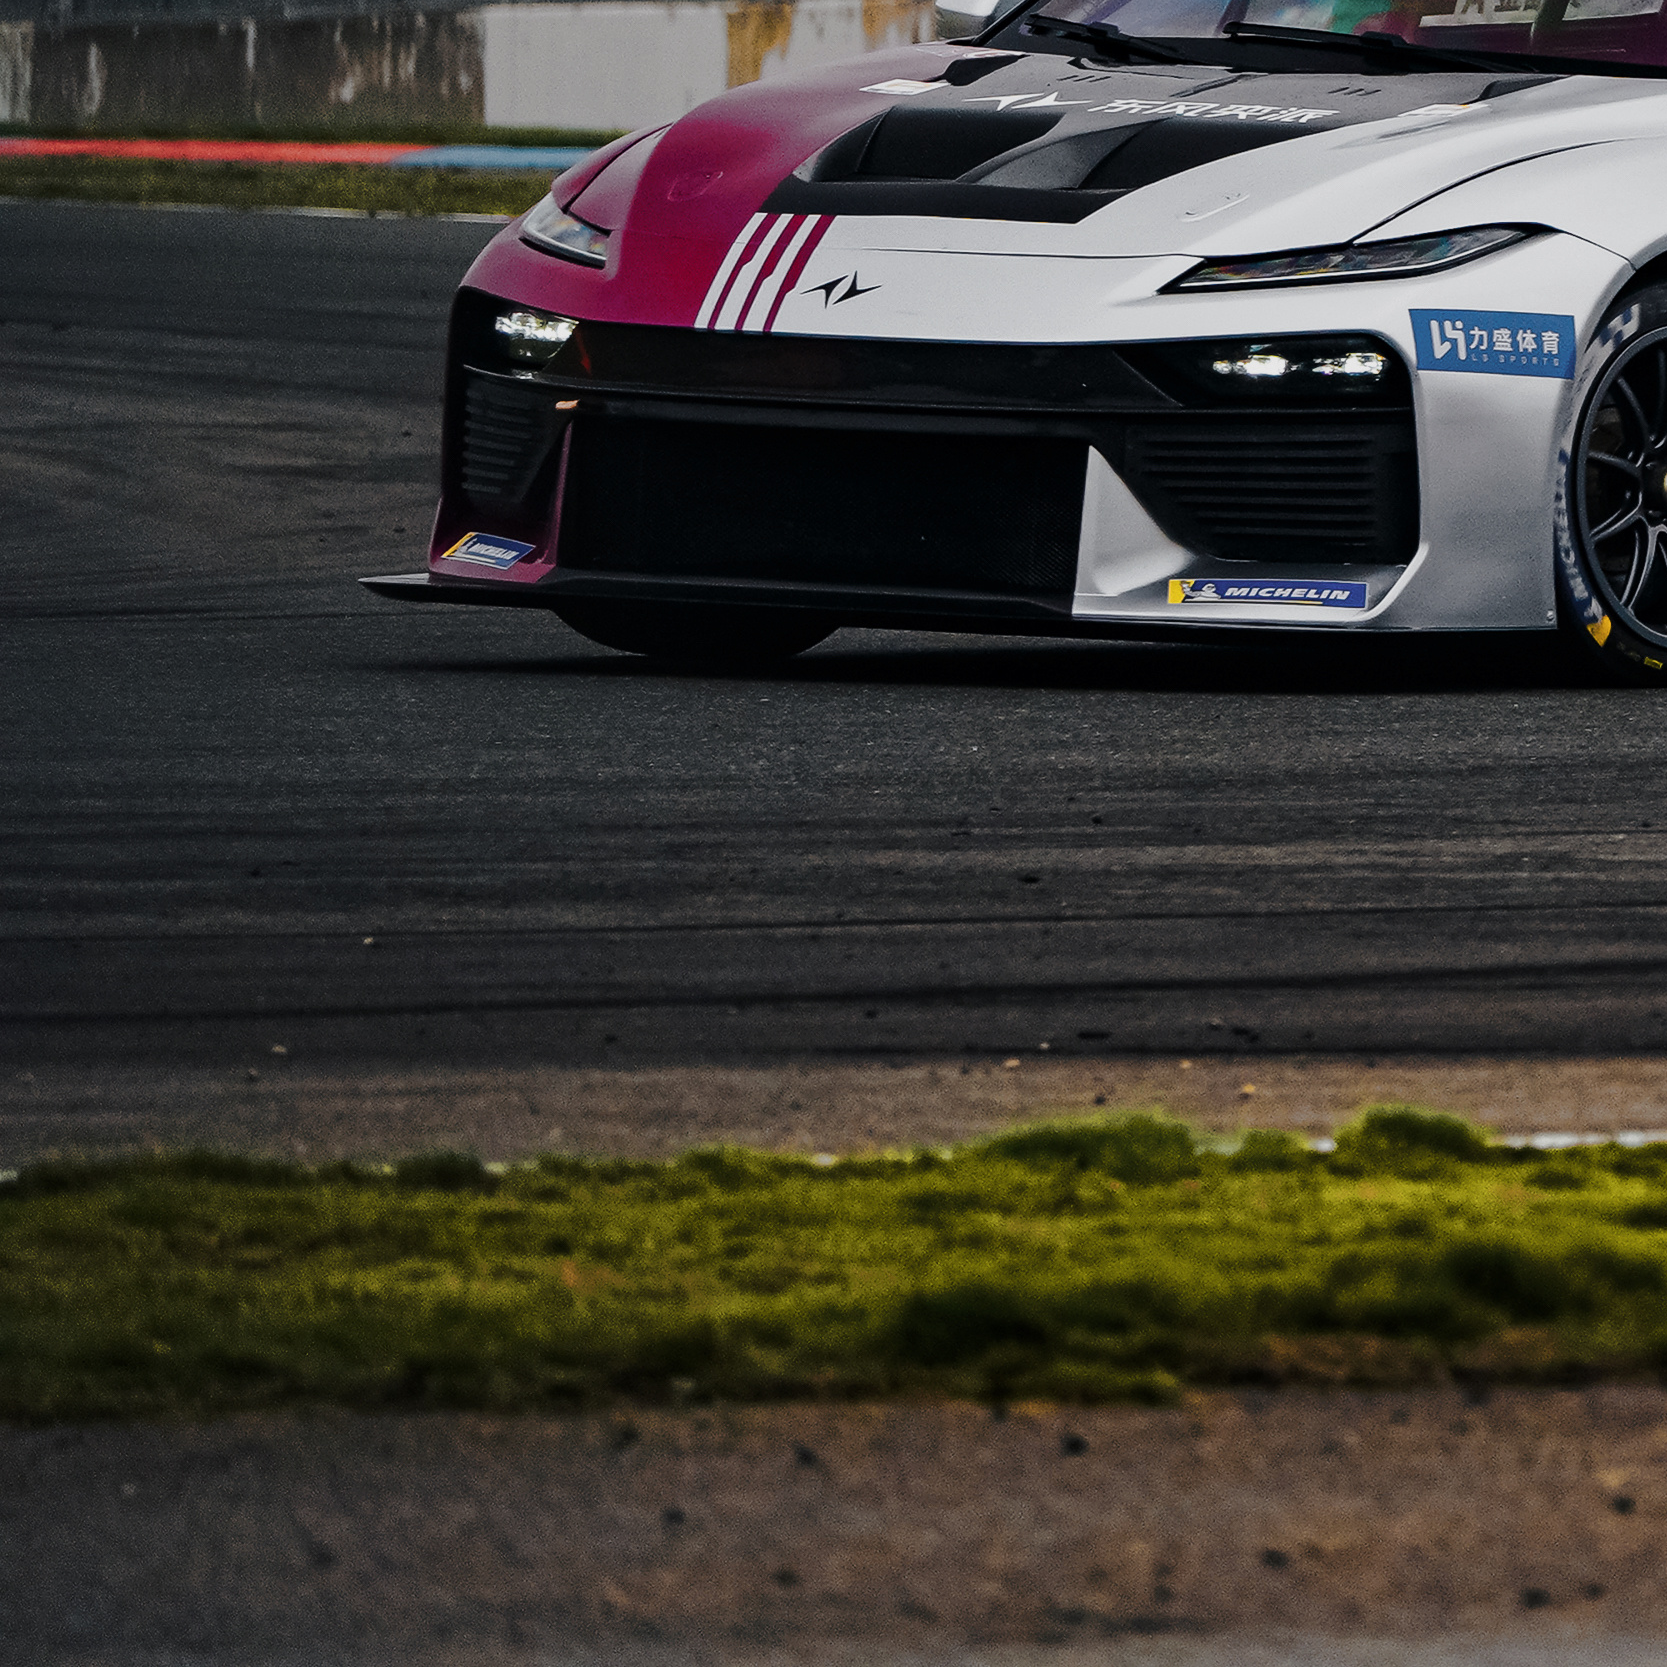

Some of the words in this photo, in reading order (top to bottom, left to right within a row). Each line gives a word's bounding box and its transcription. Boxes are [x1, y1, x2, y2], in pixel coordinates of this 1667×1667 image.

[1087, 97, 1340, 124] 东风奕派
[1469, 326, 1561, 355] 力盛体育
[1224, 586, 1351, 601] MICHELIN
